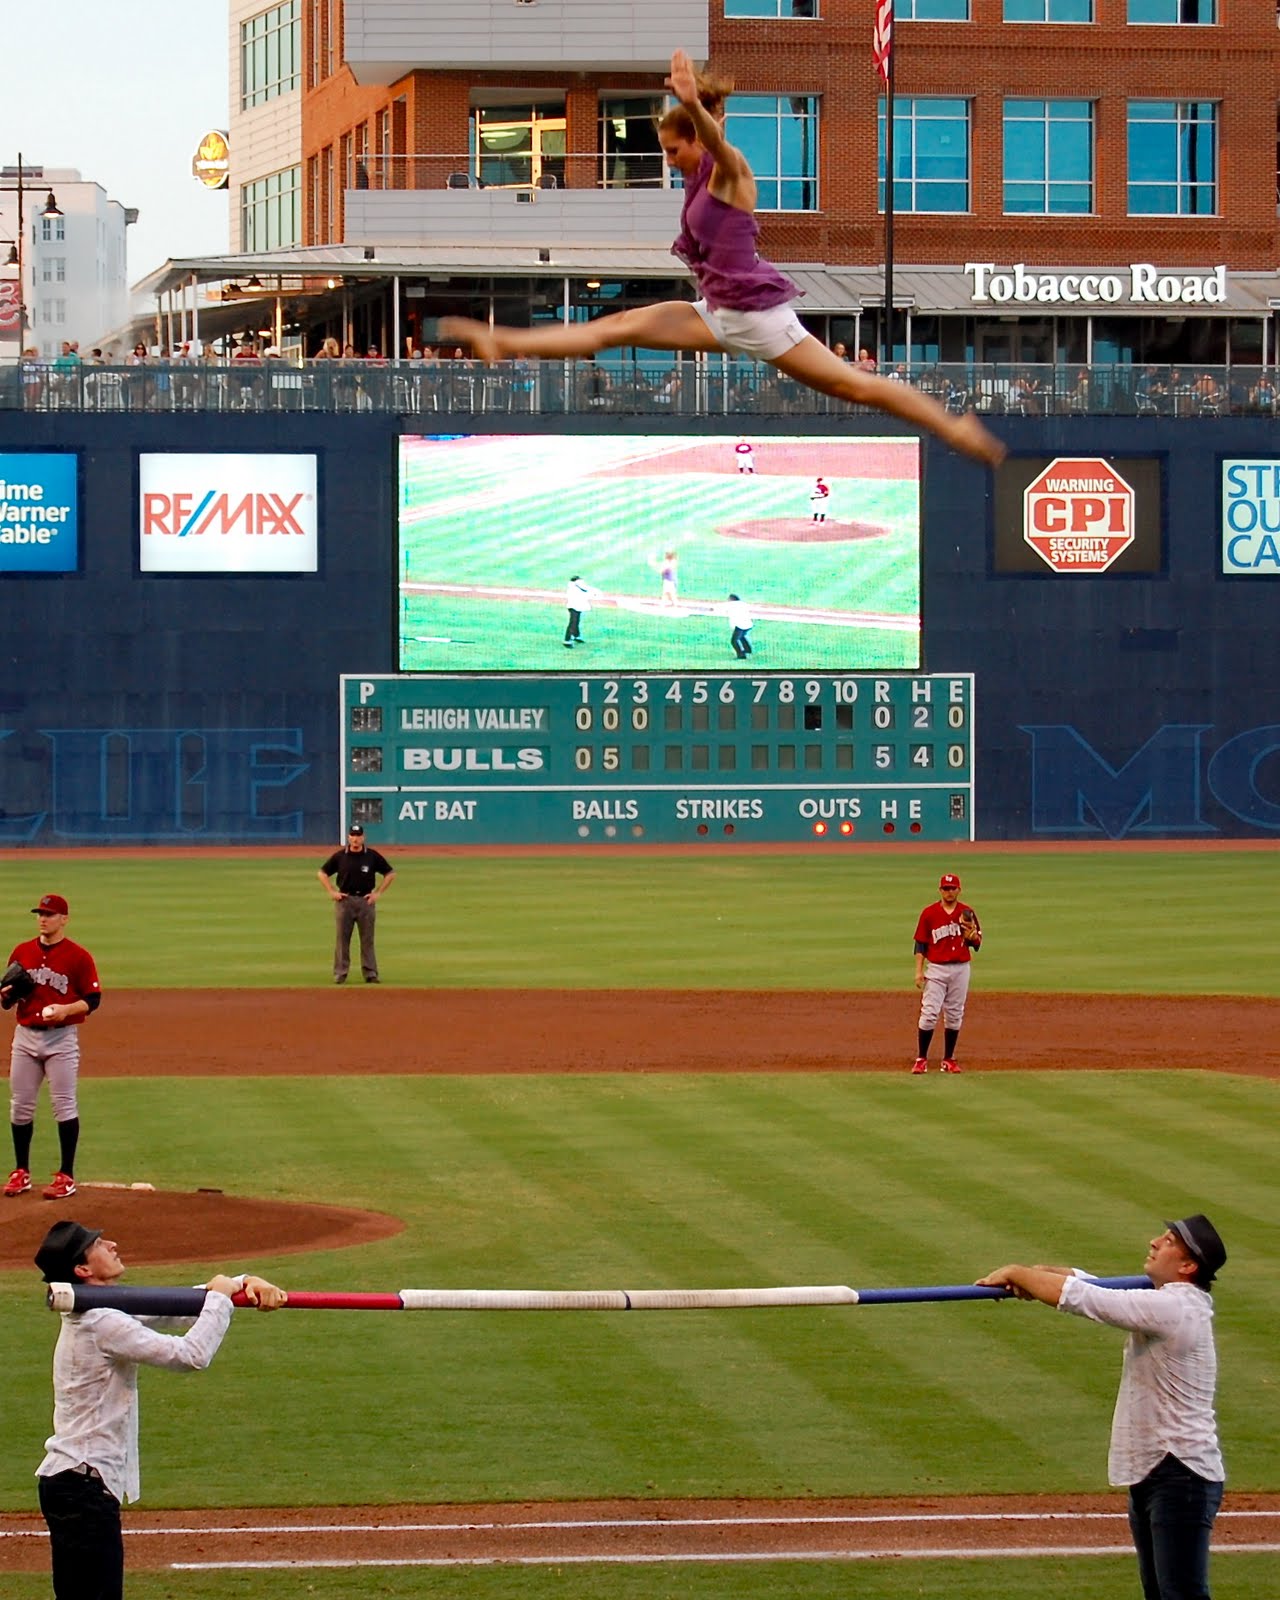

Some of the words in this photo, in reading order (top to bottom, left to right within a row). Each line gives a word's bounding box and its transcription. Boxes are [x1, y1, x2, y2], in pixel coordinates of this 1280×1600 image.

[964, 262, 1123, 302] Tobacco
[1129, 263, 1228, 303] Road
[1045, 478, 1114, 492] WARNING
[1033, 497, 1125, 532] CPI
[0, 523, 51, 543] able
[1049, 538, 1110, 550] SECURITY
[1051, 550, 1108, 563] SYSTEMS
[359, 681, 376, 704] P
[578, 681, 589, 704] 1
[603, 681, 619, 704] 2
[632, 681, 649, 704] 3
[664, 681, 682, 704] 4
[692, 681, 708, 704] 5
[718, 681, 735, 704] 6
[751, 681, 768, 704] 7
[778, 681, 795, 702] 8
[804, 681, 821, 702] 9
[832, 681, 858, 702] 10
[874, 681, 891, 702] R
[911, 681, 931, 702] H
[949, 681, 963, 702] E
[401, 708, 470, 730] LEHIGH
[475, 708, 545, 730] VALLEY
[576, 708, 592, 731] 0
[603, 708, 619, 731] 0
[632, 708, 648, 731] 0
[874, 706, 891, 729] 0
[913, 706, 929, 728] 2
[948, 706, 964, 728] 0
[403, 748, 544, 771] BULLS
[575, 747, 591, 770] 0
[603, 747, 619, 770] 5
[875, 746, 891, 768] 5
[913, 746, 929, 768] 4
[948, 745, 964, 767] 0
[398, 801, 428, 821] AT
[435, 801, 477, 821] BAT
[573, 800, 639, 819] BALLS
[676, 799, 764, 819] STRIKES
[799, 798, 861, 818] OUTS
[881, 799, 898, 819] H
[909, 799, 921, 818] E
